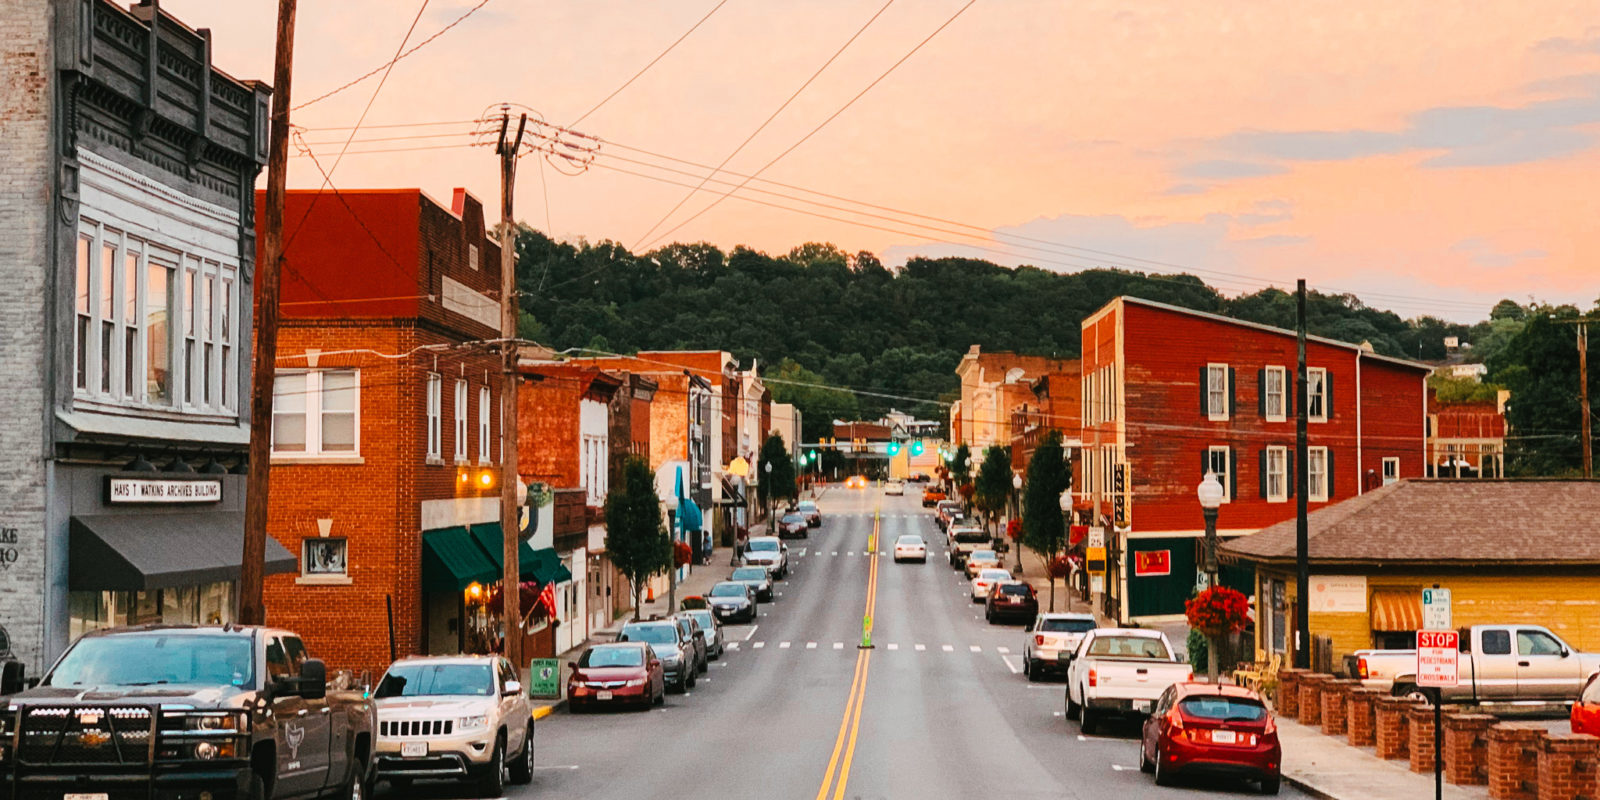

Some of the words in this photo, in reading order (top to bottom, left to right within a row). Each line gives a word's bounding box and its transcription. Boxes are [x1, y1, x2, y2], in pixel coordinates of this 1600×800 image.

[114, 483, 130, 496] HAYS
[133, 483, 137, 496] T
[141, 484, 164, 496] WATKINS
[167, 484, 192, 497] ARCHIVES
[195, 484, 217, 496] BUILDING
[1421, 633, 1454, 647] STOP
[1420, 656, 1455, 664] PEDESTRIANS
[1420, 673, 1455, 681] CROSSWALK
